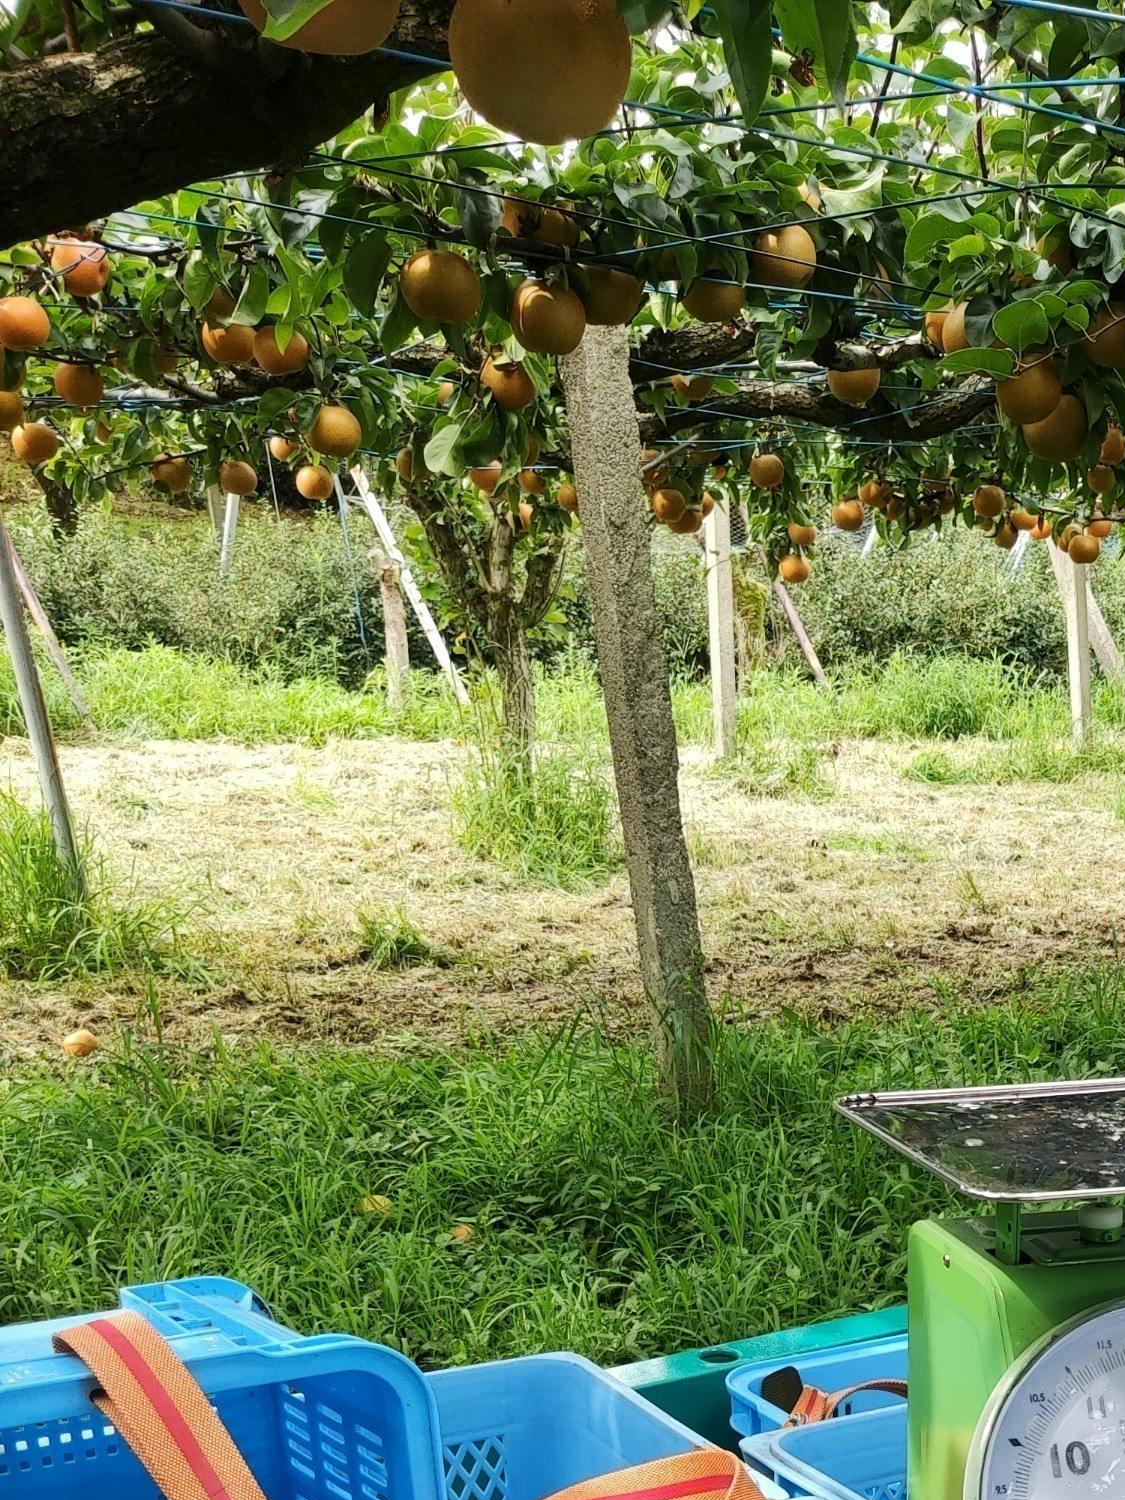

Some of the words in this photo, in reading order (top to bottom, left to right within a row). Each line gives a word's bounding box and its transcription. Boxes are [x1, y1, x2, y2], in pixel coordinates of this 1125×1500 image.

[1096, 1339, 1112, 1350] 11.5
[1029, 1392, 1046, 1403] 10.5
[1050, 1440, 1090, 1479] 10
[995, 1484, 1008, 1495] 9.5
